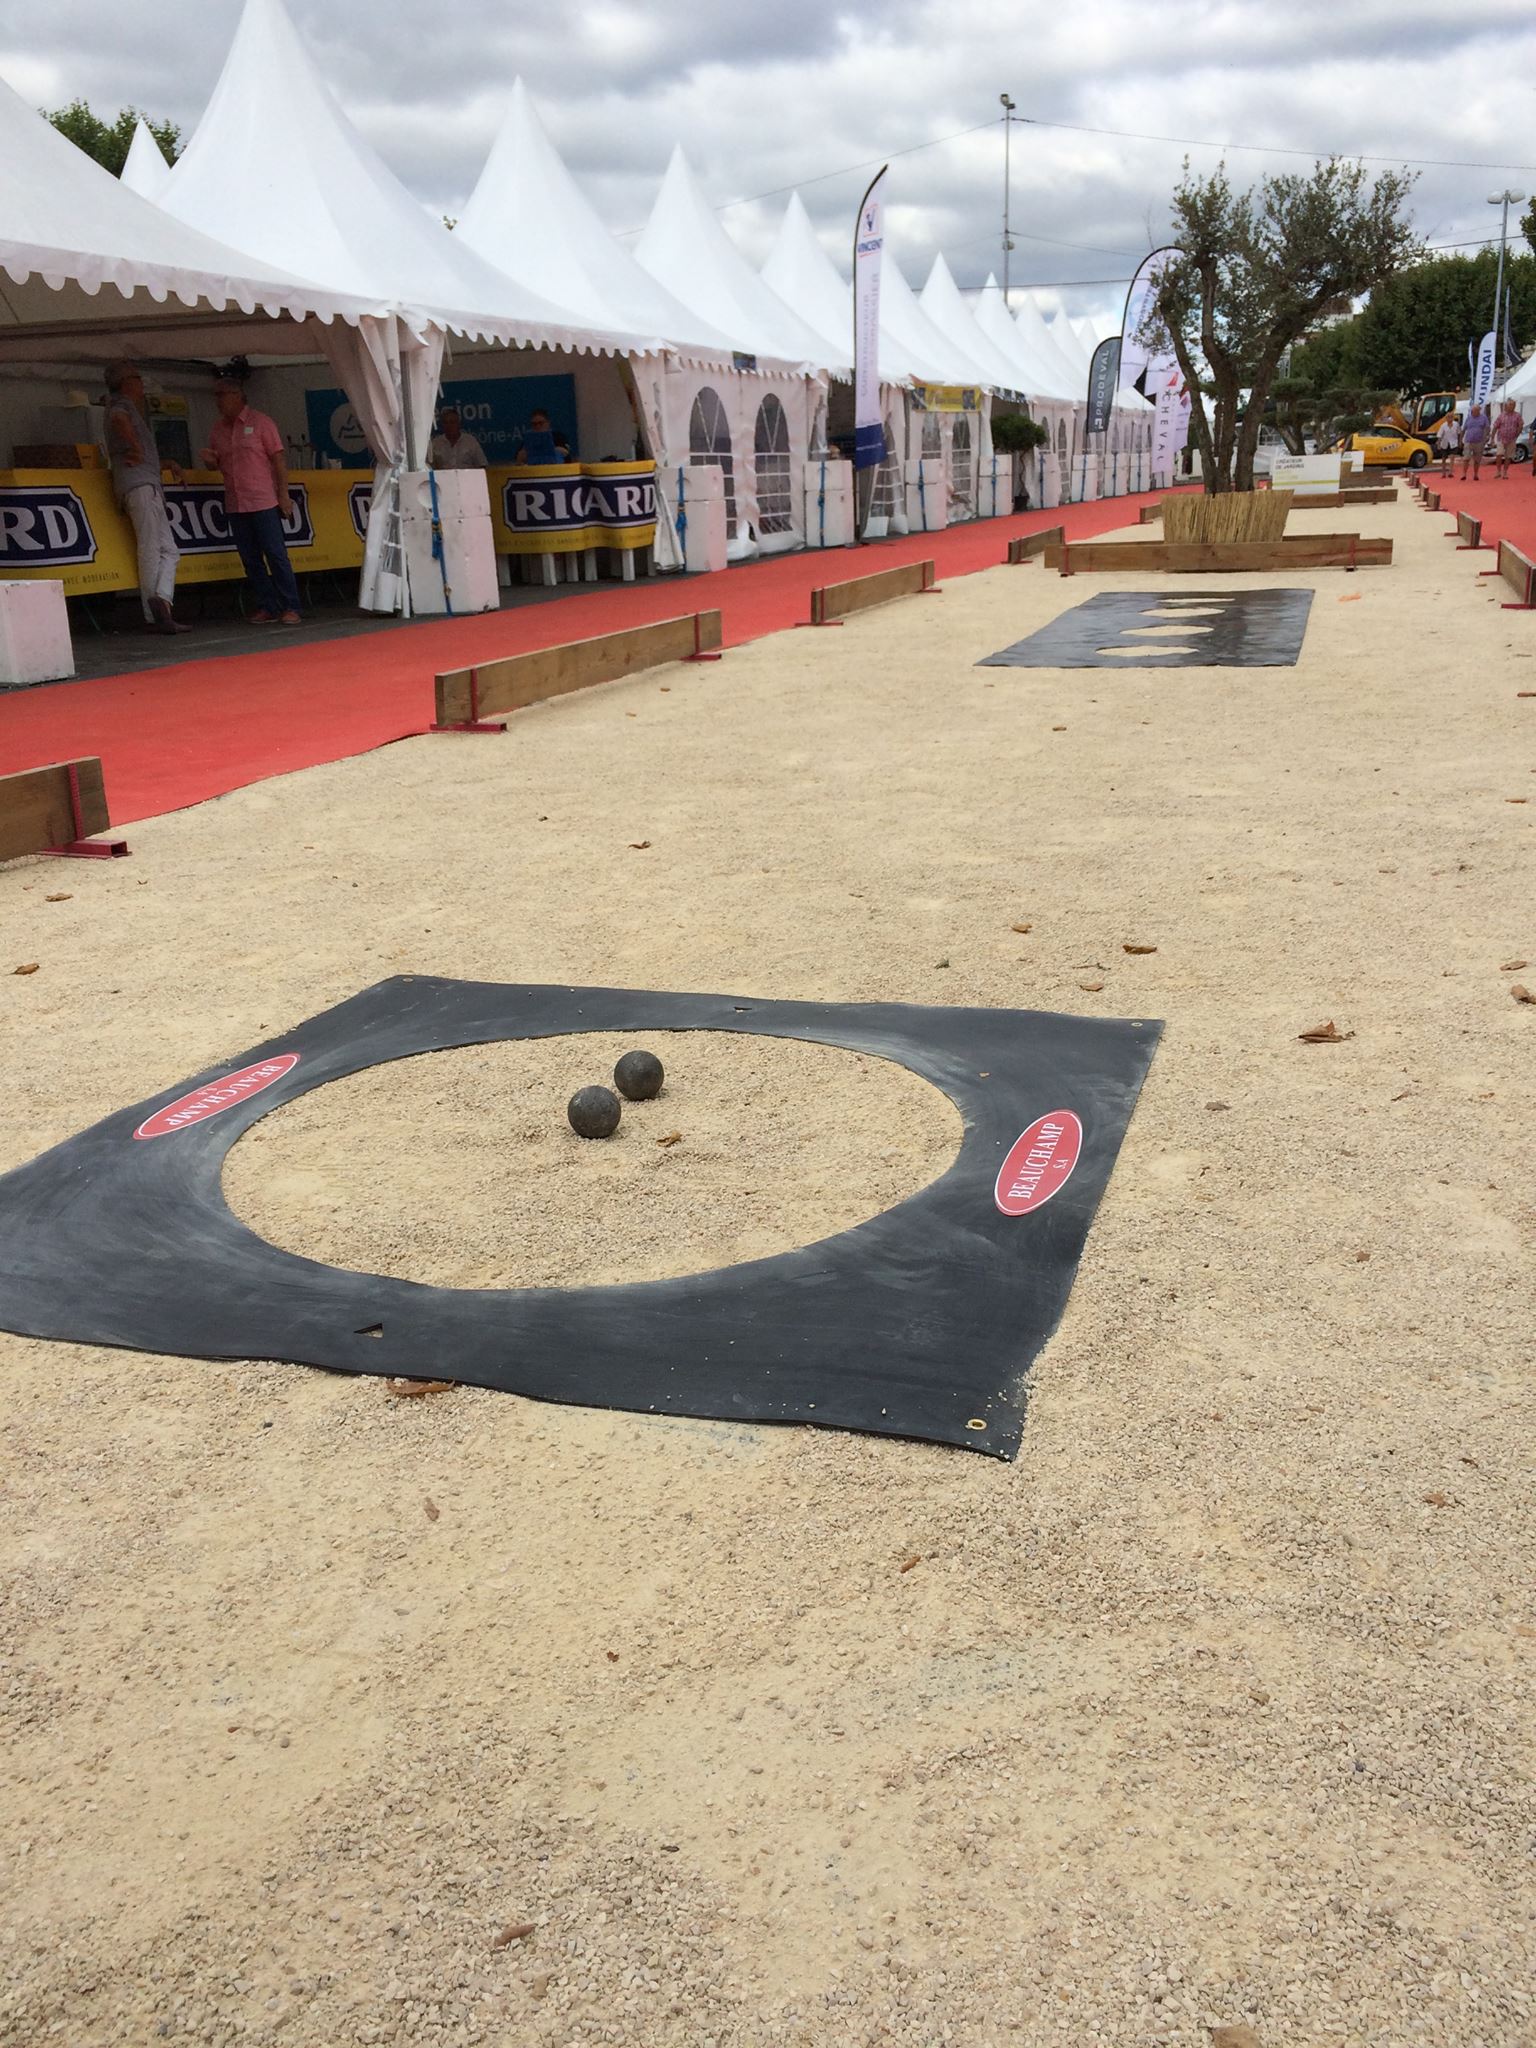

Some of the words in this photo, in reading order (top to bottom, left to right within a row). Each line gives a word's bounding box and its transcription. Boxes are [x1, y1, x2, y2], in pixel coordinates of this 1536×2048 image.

[1096, 350, 1110, 416] PRODEVAL
[1479, 349, 1492, 405] YUNDAI
[512, 484, 656, 521] RICARD
[164, 1065, 282, 1126] BEAUCHAMP
[1007, 1122, 1065, 1199] BEAUCHAMP
